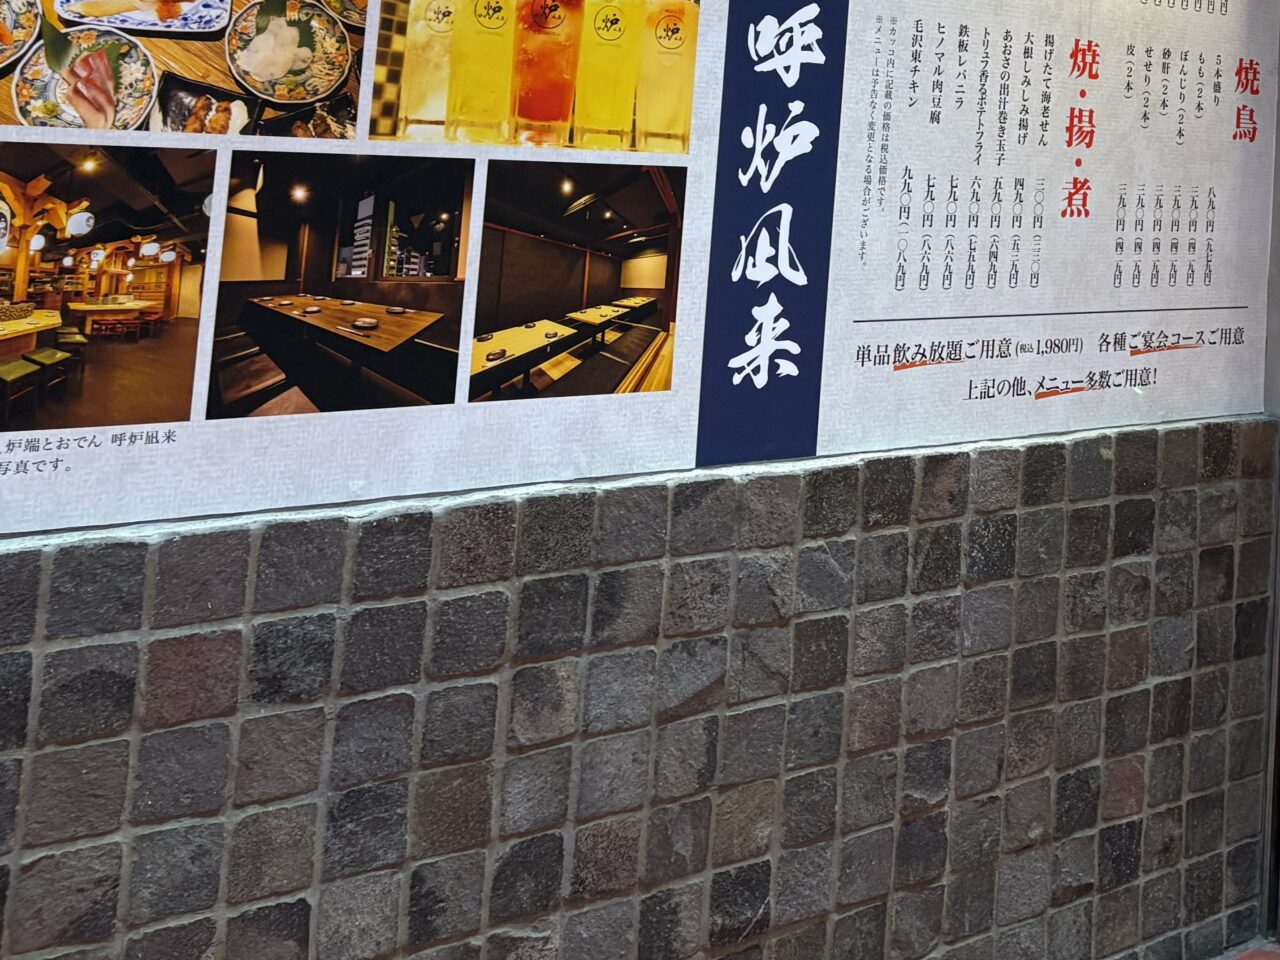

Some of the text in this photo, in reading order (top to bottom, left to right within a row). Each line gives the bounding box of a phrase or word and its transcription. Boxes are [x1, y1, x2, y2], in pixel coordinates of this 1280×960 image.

[907, 18, 924, 108] 毛沢東チキン
[929, 22, 946, 125] ヒノマル肉豆腐
[954, 23, 970, 110] 鉄板レバニラ
[973, 26, 991, 166] トリュフ香るポテトフライ
[993, 29, 1013, 167] あおさの出汁巻き玉子
[1017, 31, 1035, 146] 大根しみしみ揚げ
[1037, 33, 1055, 147] 揚げたて海老せん
[1213, 54, 1223, 108] 5本盛り
[1232, 57, 1261, 143] 焼鳥
[1060, 38, 1102, 219] 焼・揚・煮
[856, 338, 1012, 368] 単品飲み放題ご用意
[1097, 326, 1245, 353] 各種ご宴会コースご用意
[962, 367, 1158, 401] 上記の他、メニュー多数ご用意!
